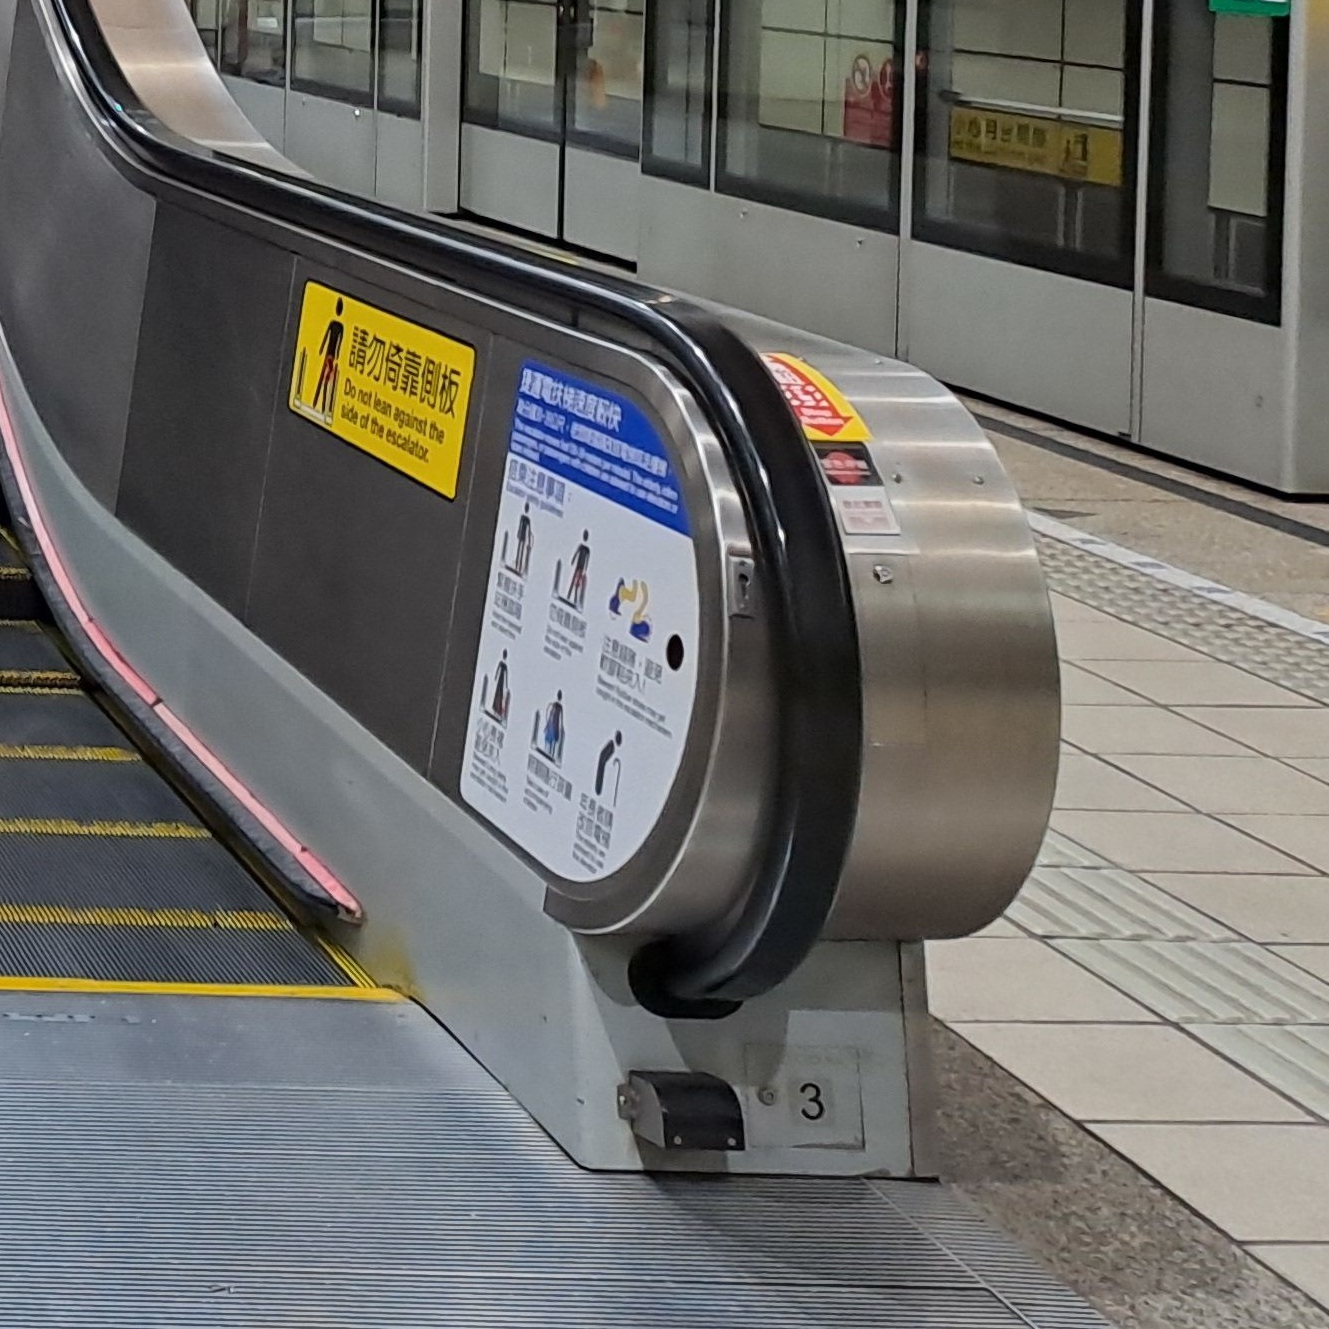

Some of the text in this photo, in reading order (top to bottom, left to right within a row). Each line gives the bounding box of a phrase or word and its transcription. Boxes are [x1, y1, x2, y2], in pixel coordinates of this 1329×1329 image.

[349, 325, 461, 418] 請勿倚靠側板
[341, 402, 430, 463] side of the escalator.
[344, 377, 445, 444] Do not lean against the
[799, 1082, 825, 1120] 3
